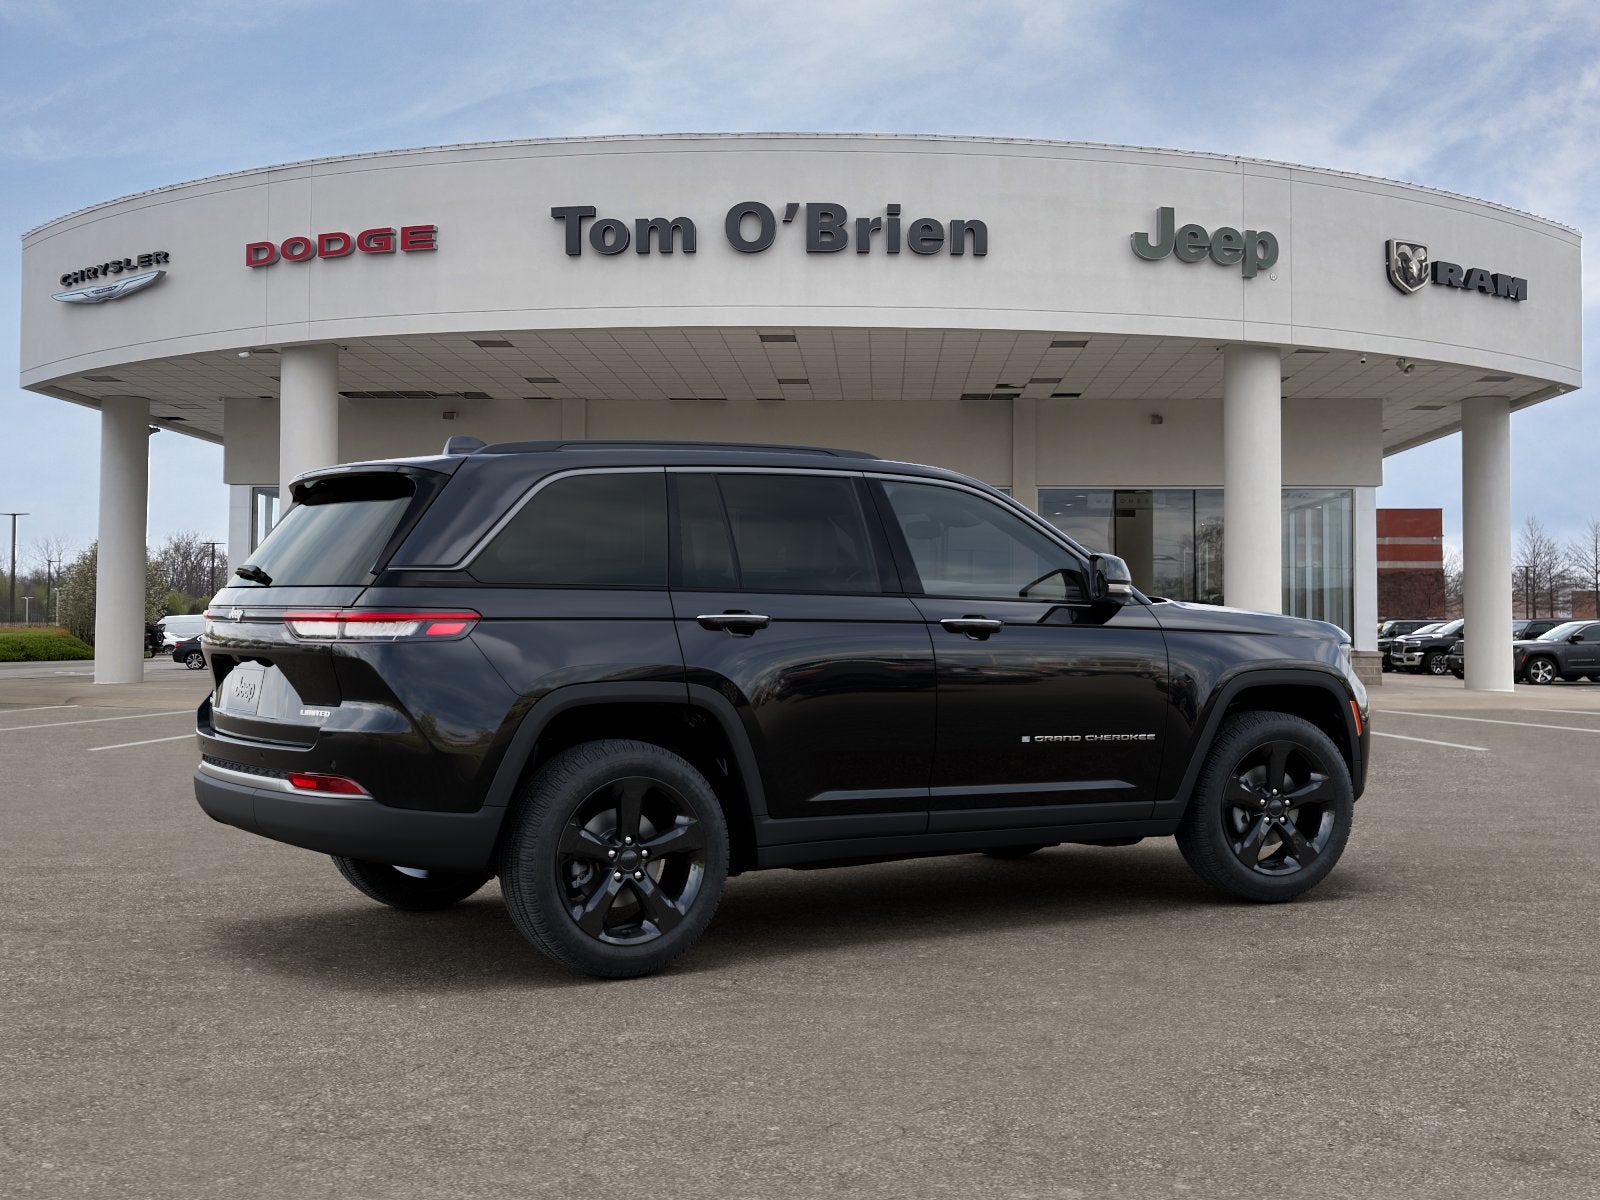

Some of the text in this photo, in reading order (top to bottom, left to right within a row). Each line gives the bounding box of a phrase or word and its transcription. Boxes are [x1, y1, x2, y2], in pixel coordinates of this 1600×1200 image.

[245, 224, 438, 268] DODGE
[551, 201, 988, 256] Tom O'Brien
[1130, 207, 1279, 278] Jeep
[60, 250, 170, 287] CHRYSLER
[1431, 261, 1528, 301] RAM
[300, 709, 331, 717] LIMITED
[1085, 733, 1156, 741] CHEROKEE
